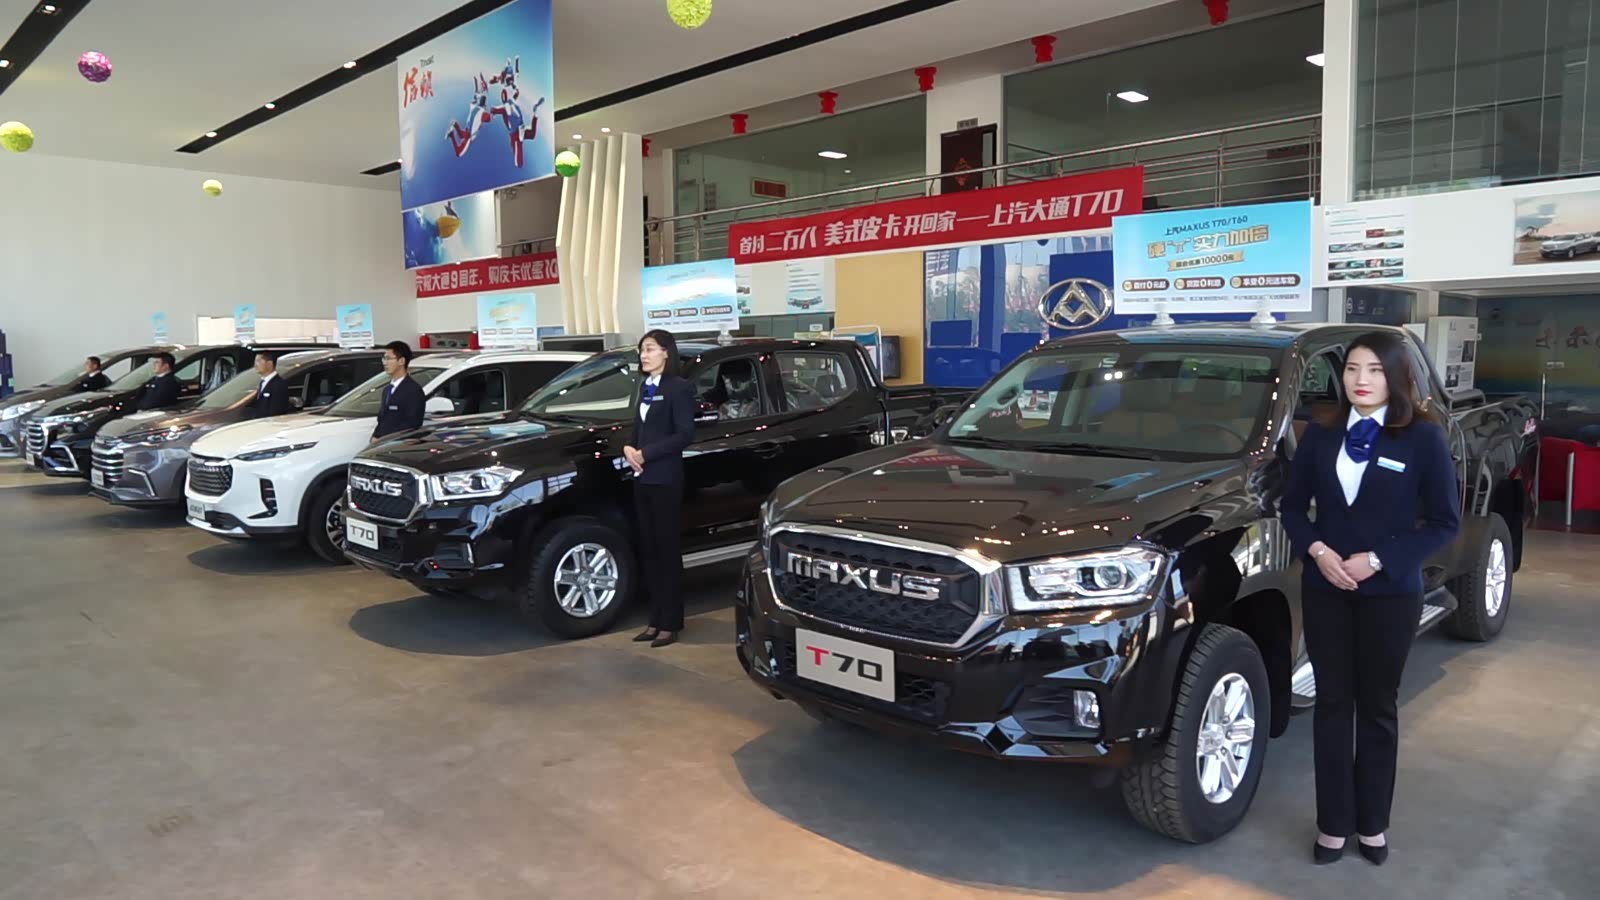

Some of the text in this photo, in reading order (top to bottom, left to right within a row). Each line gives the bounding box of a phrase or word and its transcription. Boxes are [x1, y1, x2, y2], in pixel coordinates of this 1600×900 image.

[1212, 215, 1249, 229] T70/T60
[350, 475, 403, 497] MAXUS
[349, 524, 375, 542] T70
[787, 551, 943, 601] MAXUS
[805, 645, 883, 682] T70
